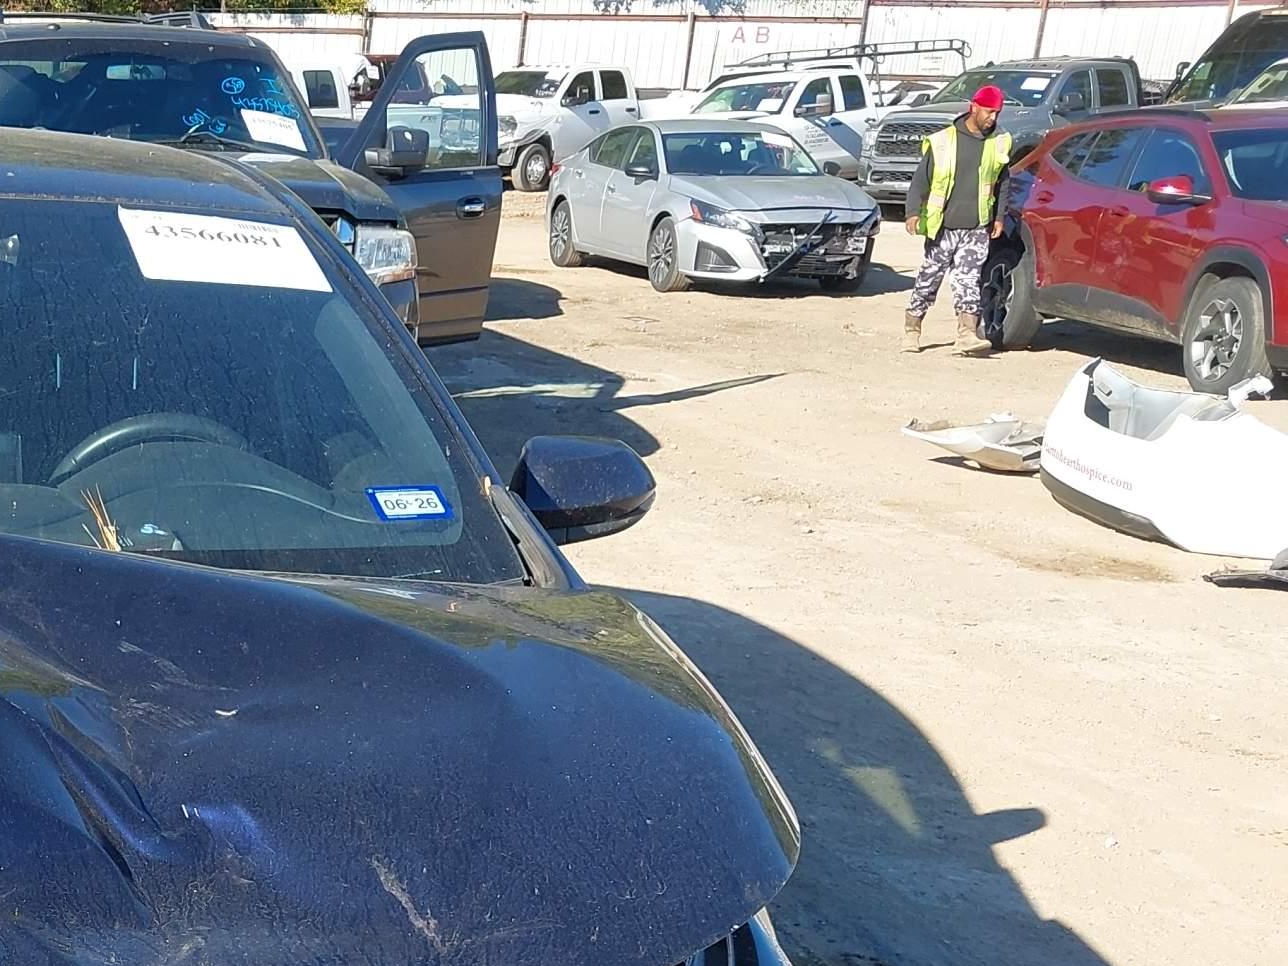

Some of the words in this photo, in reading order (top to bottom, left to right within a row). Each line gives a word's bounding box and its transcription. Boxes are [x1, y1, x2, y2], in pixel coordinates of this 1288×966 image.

[731, 26, 745, 43] A
[755, 26, 770, 43] B
[145, 225, 282, 248] 43566081
